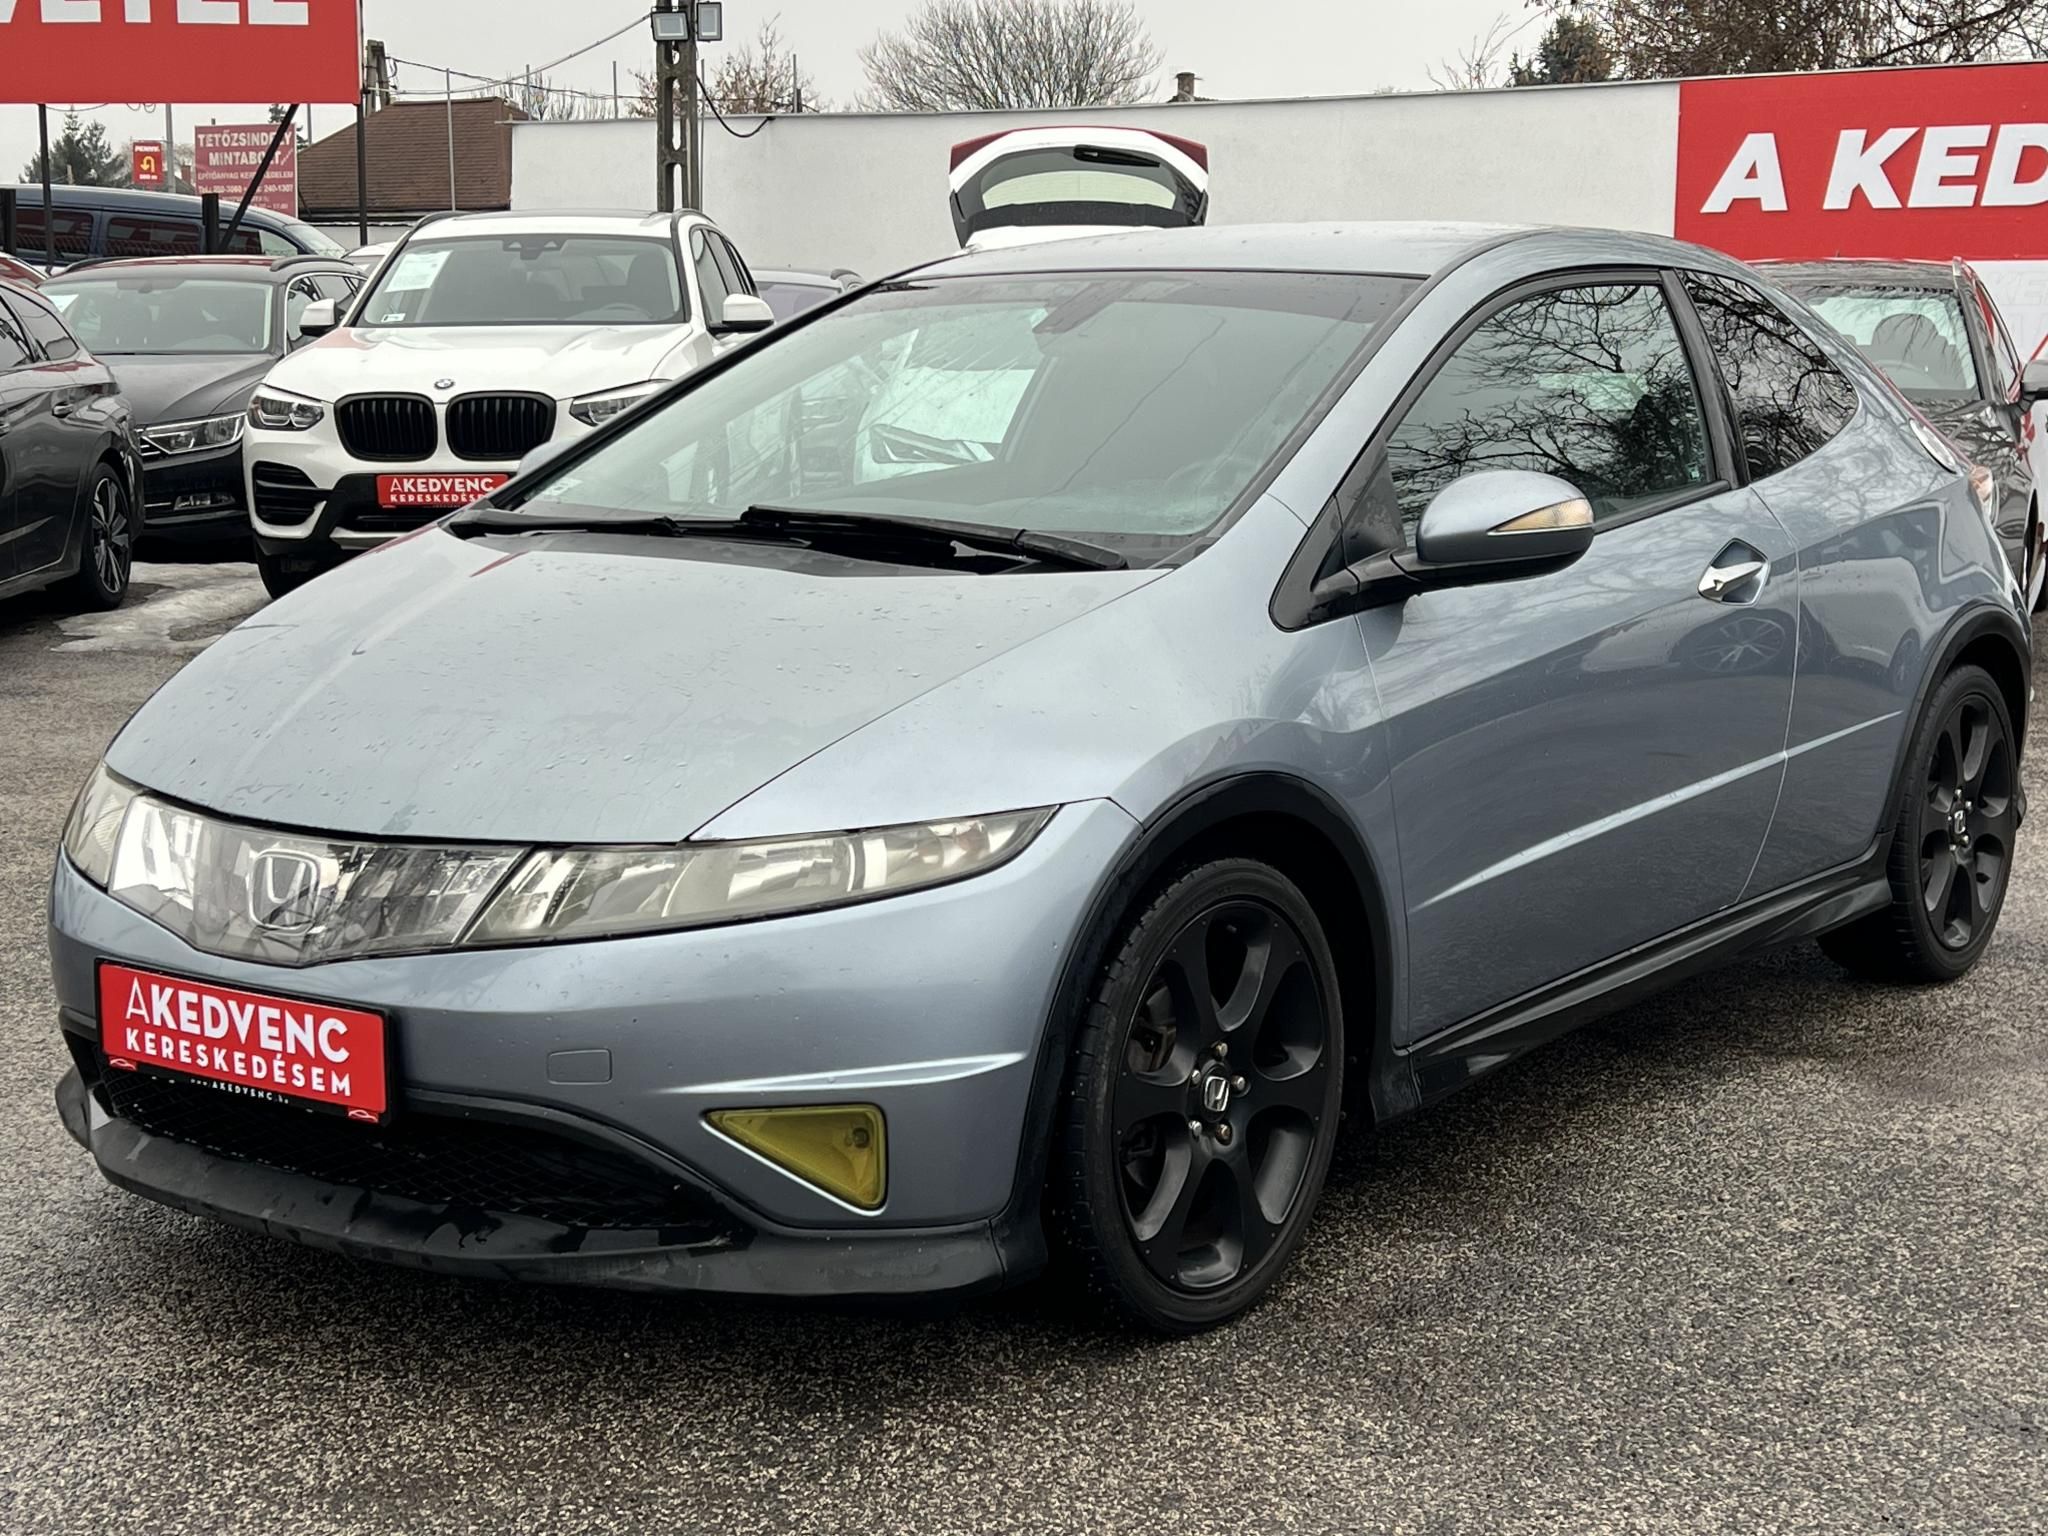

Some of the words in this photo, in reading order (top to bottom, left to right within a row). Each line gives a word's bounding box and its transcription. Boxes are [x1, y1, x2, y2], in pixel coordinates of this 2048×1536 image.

[198, 129, 292, 147] TETŐZSINDEY
[208, 150, 282, 166] MINTABOT
[1699, 132, 1789, 214] A
[125, 1027, 352, 1097] KERESKEDÉSEM
